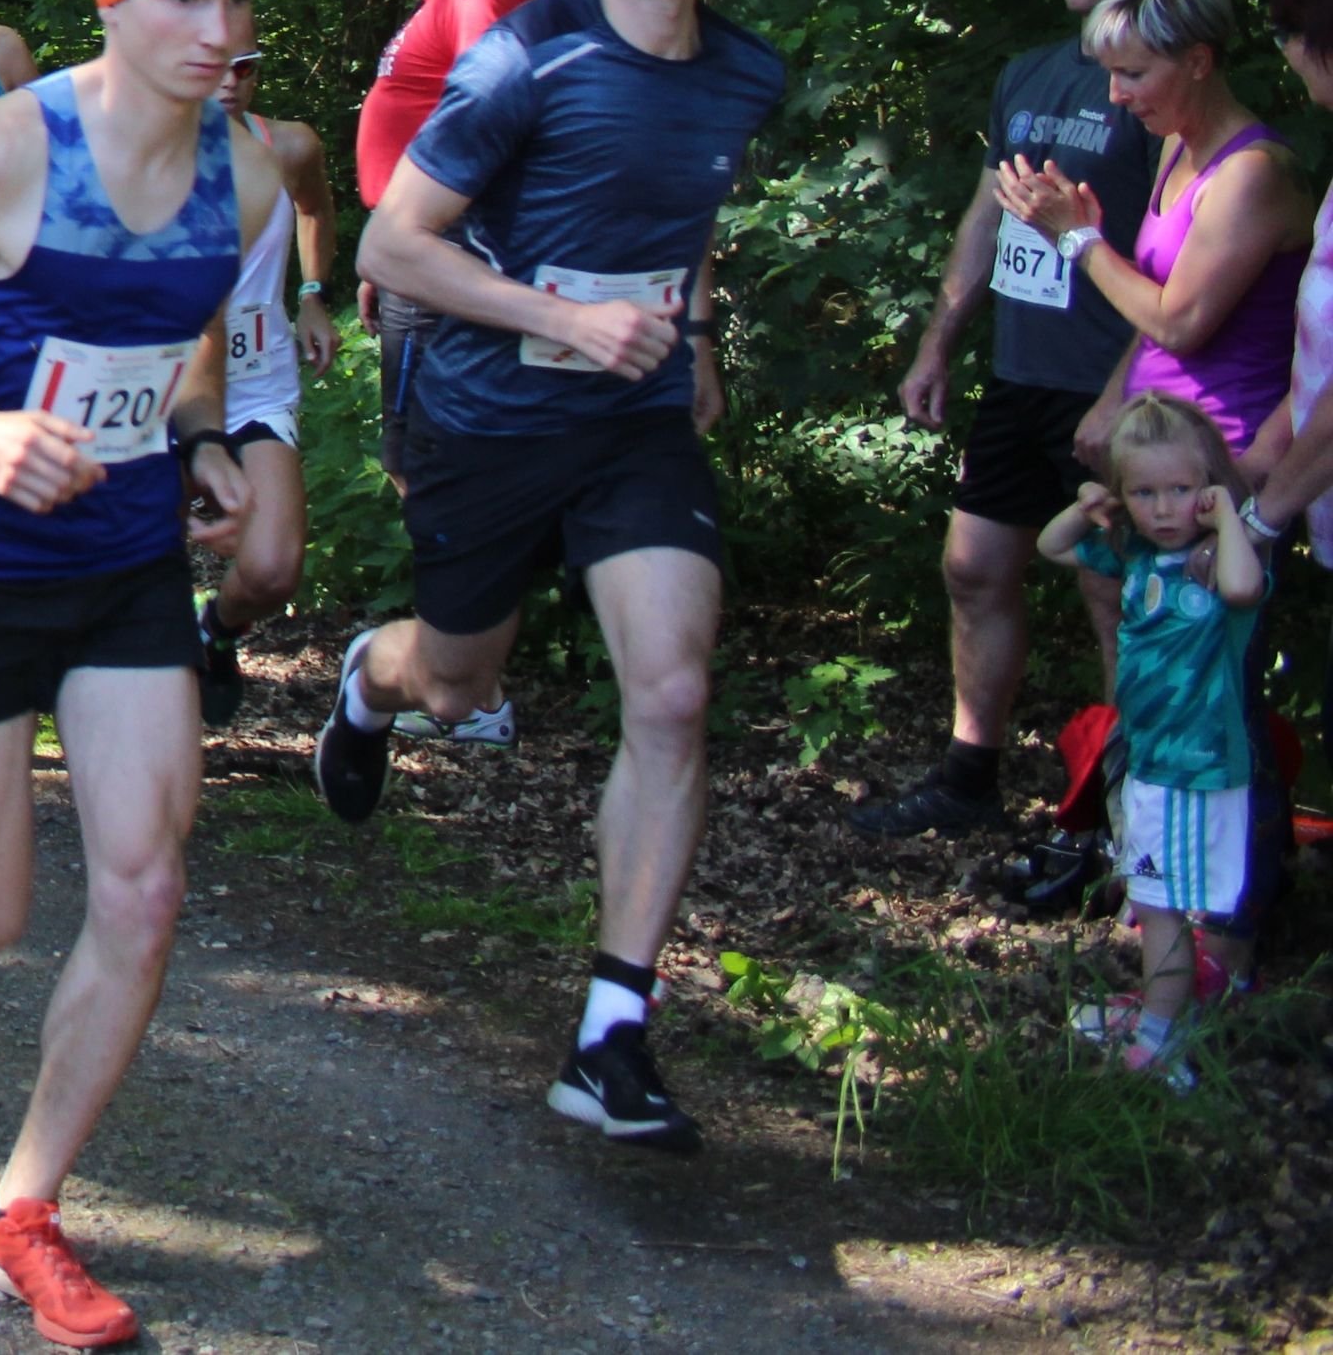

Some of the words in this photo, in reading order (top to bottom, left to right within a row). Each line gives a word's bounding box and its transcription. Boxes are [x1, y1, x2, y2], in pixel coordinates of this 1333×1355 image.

[1029, 115, 1112, 154] SPRTAN
[1002, 242, 1046, 277] 467
[77, 387, 156, 429] 120
